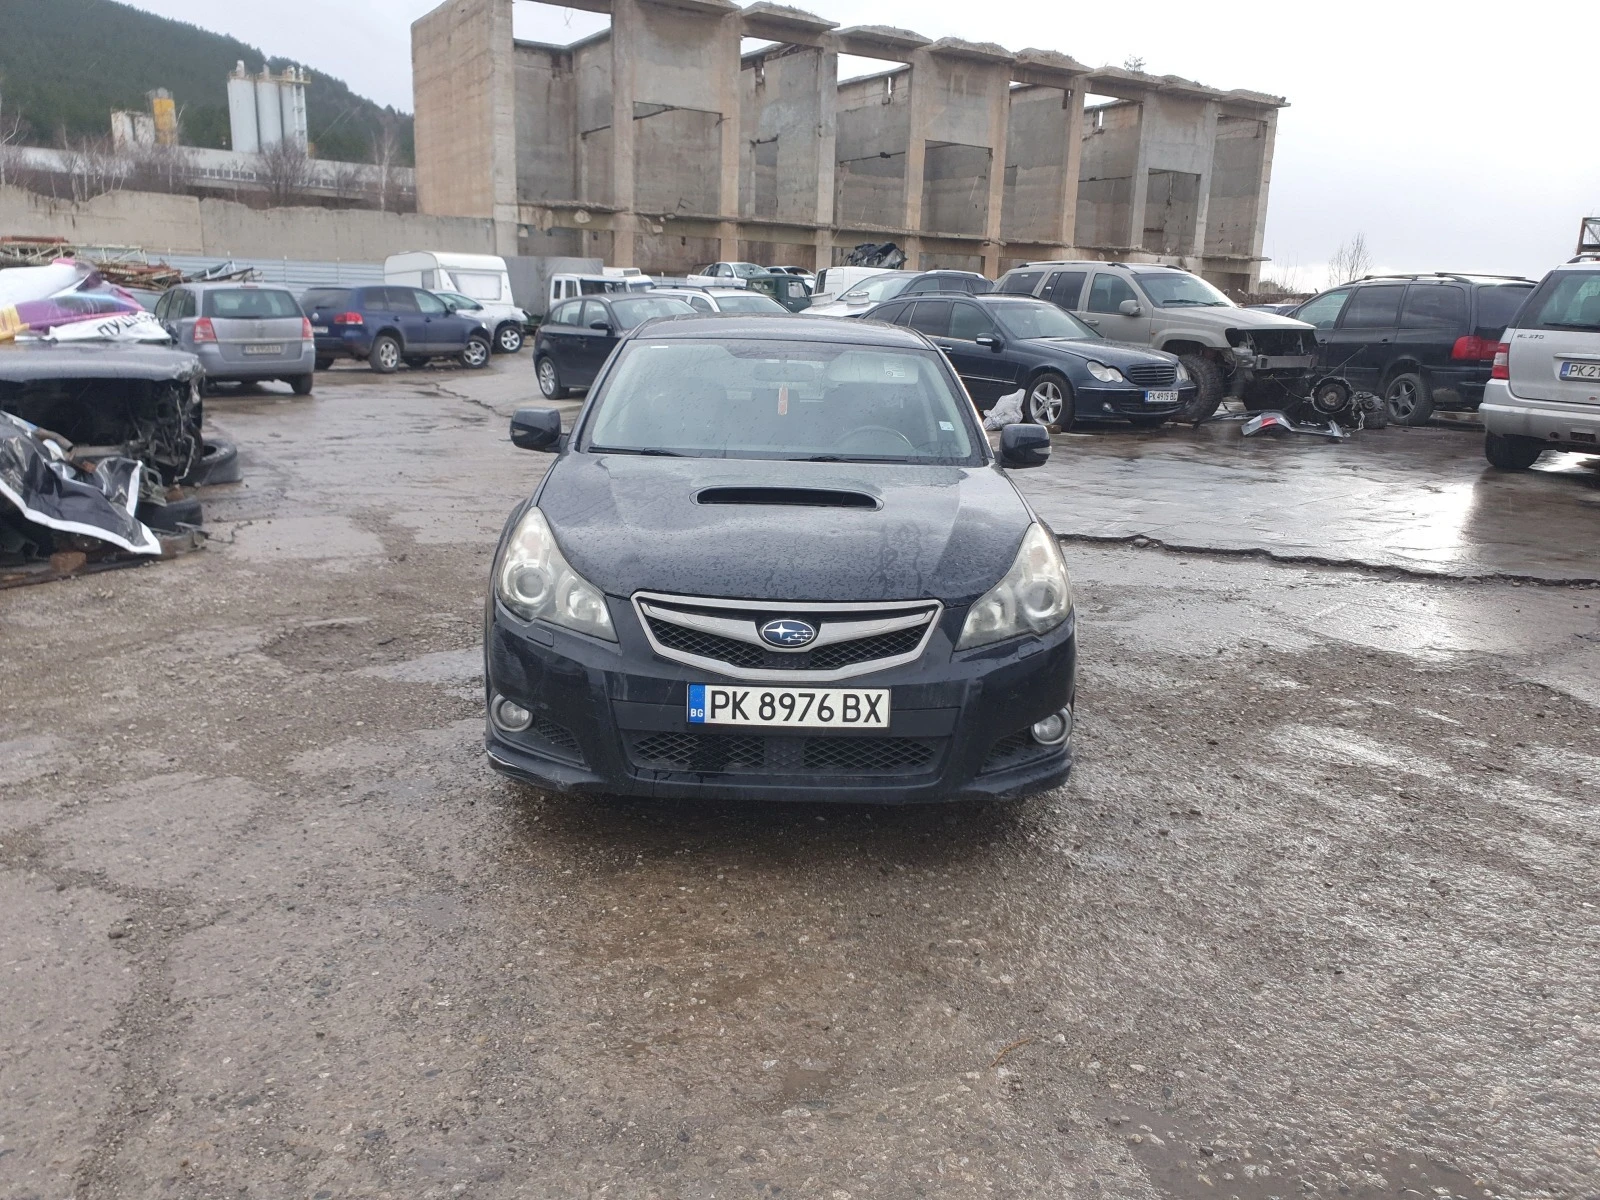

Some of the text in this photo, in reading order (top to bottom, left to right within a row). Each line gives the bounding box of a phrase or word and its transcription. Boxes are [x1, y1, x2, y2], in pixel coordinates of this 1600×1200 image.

[1568, 364, 1587, 377] PK
[1148, 392, 1157, 401] PK
[710, 690, 883, 723] PK 8976 BX
[690, 708, 704, 718] BG
